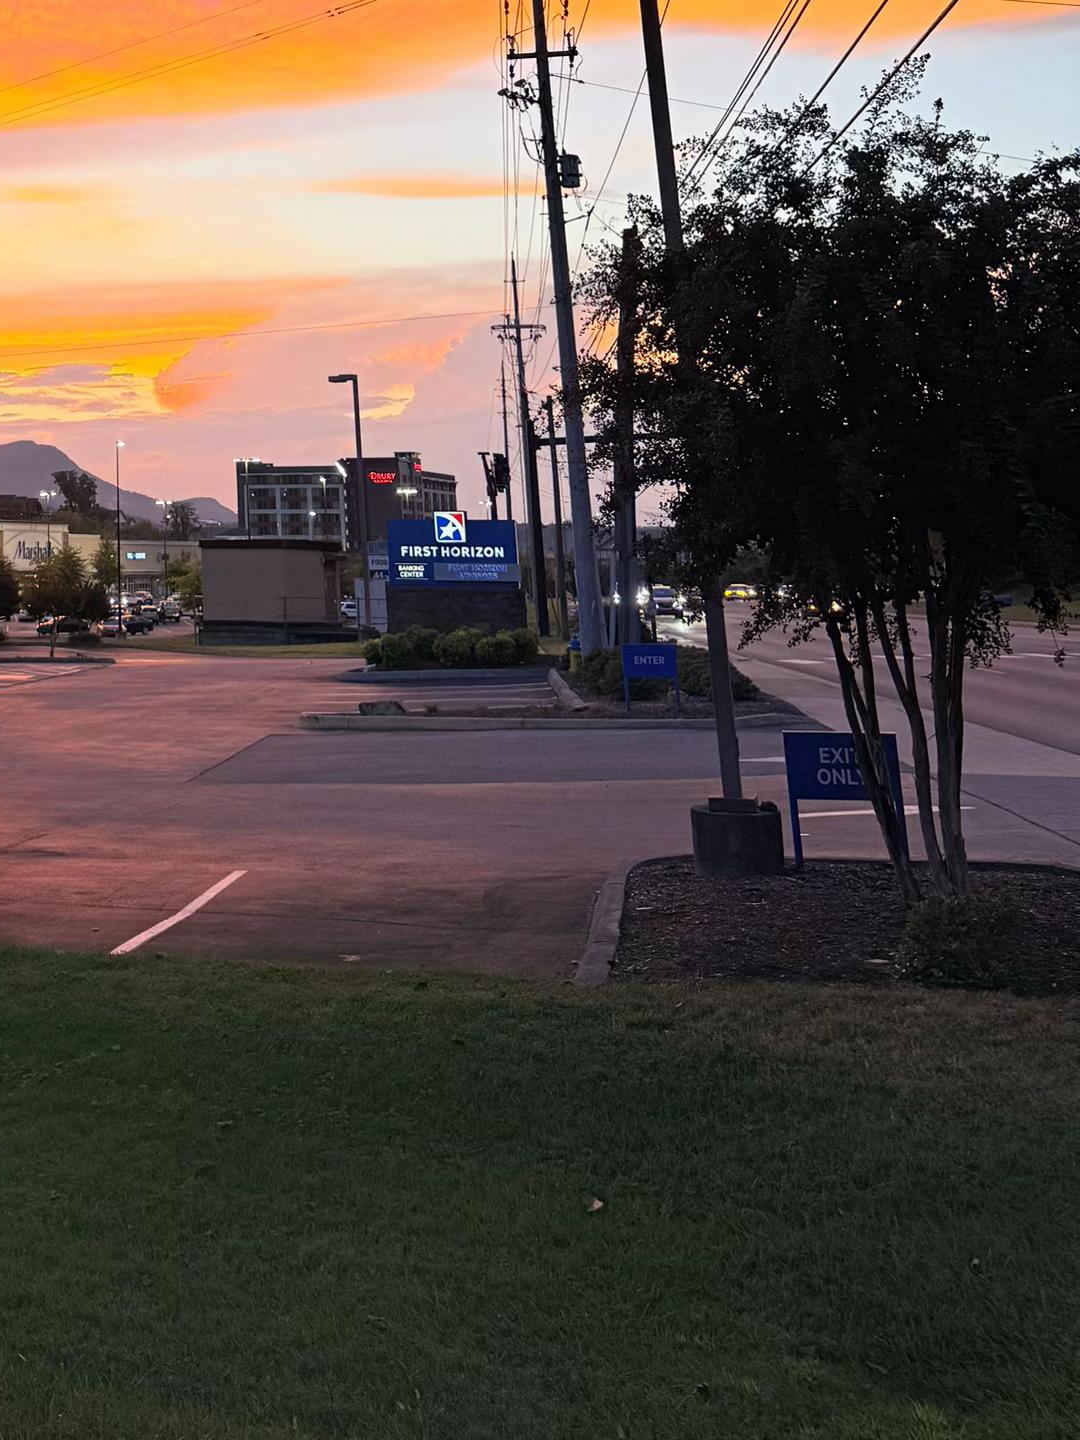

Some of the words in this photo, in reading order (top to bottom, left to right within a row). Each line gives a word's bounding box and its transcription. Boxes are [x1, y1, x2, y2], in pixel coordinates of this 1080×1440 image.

[369, 471, 396, 480] DRURY
[400, 545, 438, 557] FIRST
[441, 546, 505, 558] HORIZON
[633, 655, 665, 665] ENTER
